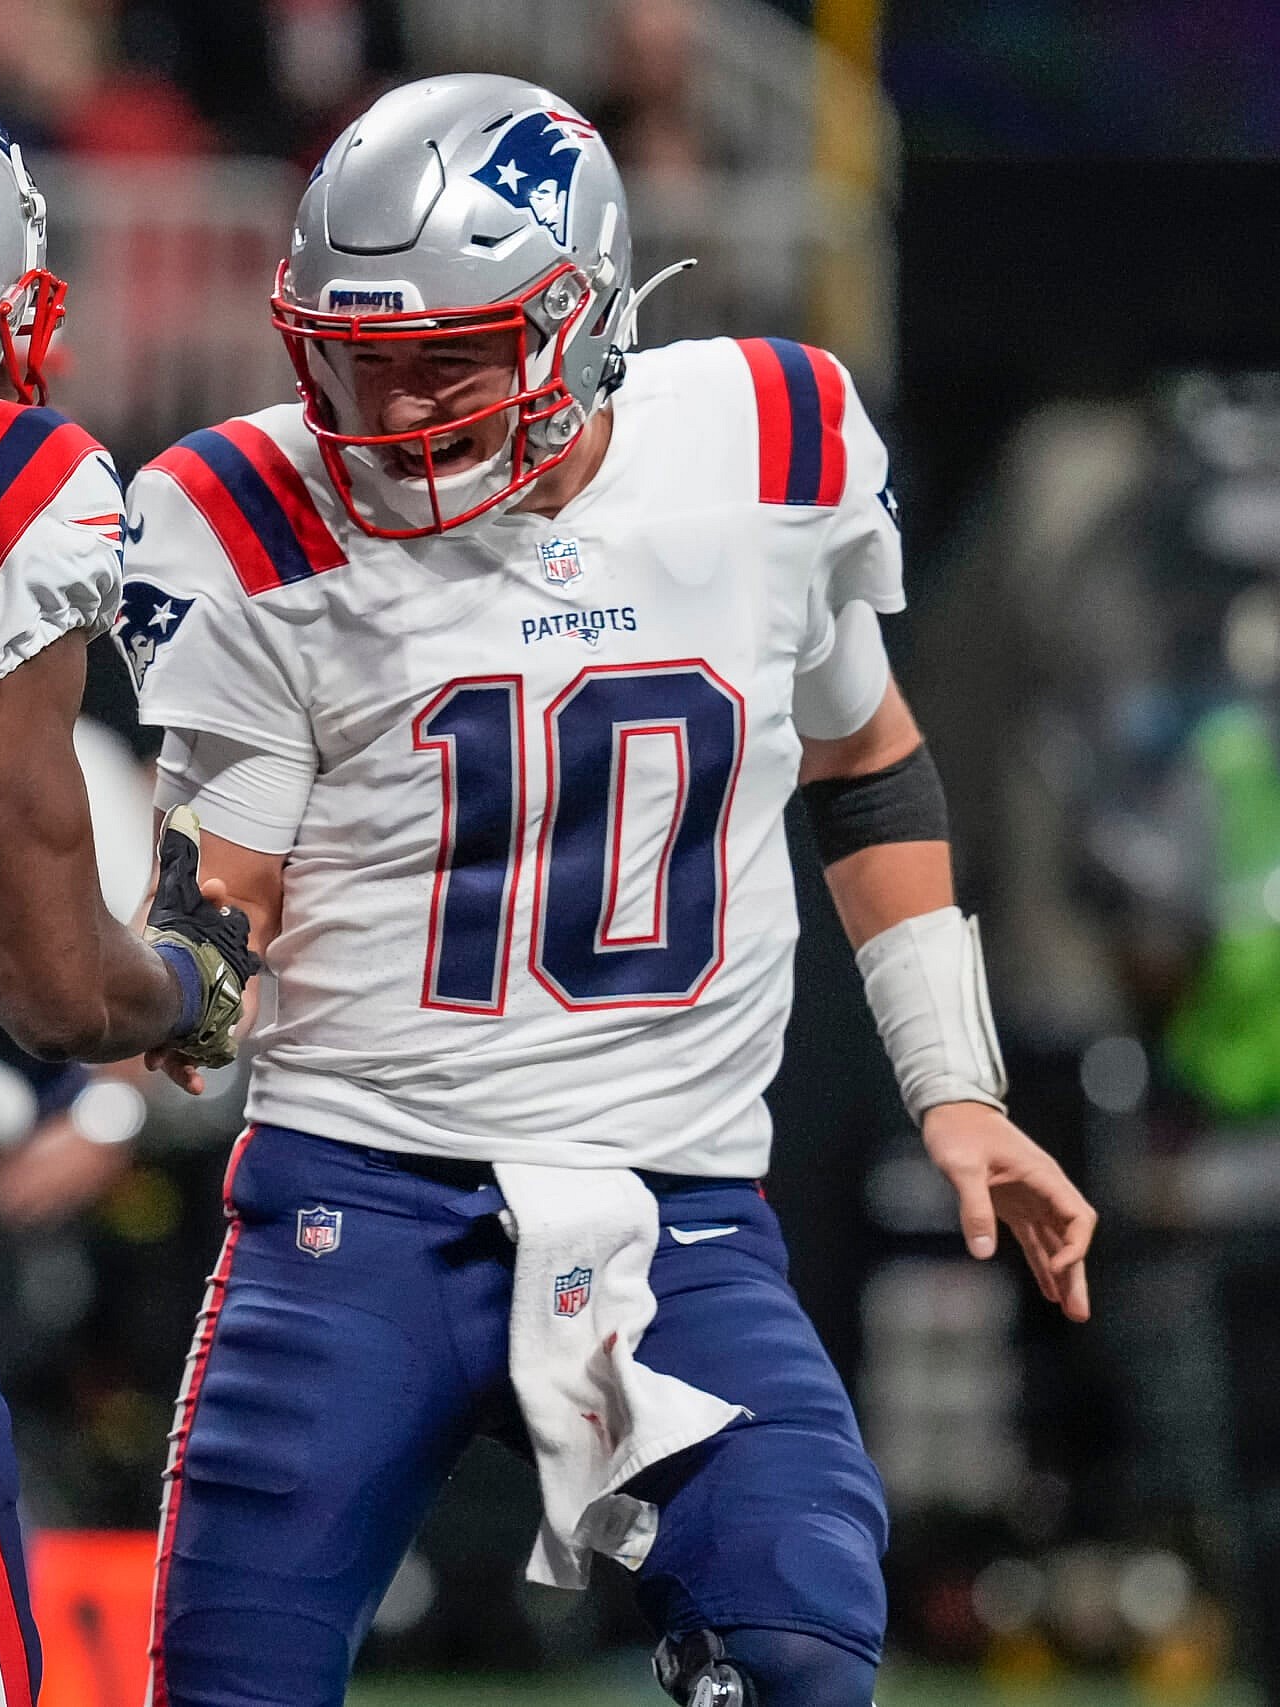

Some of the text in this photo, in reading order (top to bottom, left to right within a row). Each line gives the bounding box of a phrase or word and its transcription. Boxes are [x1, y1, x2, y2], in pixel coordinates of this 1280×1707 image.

[329, 290, 404, 313] PATRIOTS
[548, 557, 578, 578] NFL
[521, 606, 637, 645] PATRIOTS
[412, 657, 746, 1017] 10
[304, 1228, 334, 1248] NFL
[558, 1286, 588, 1313] NFL
